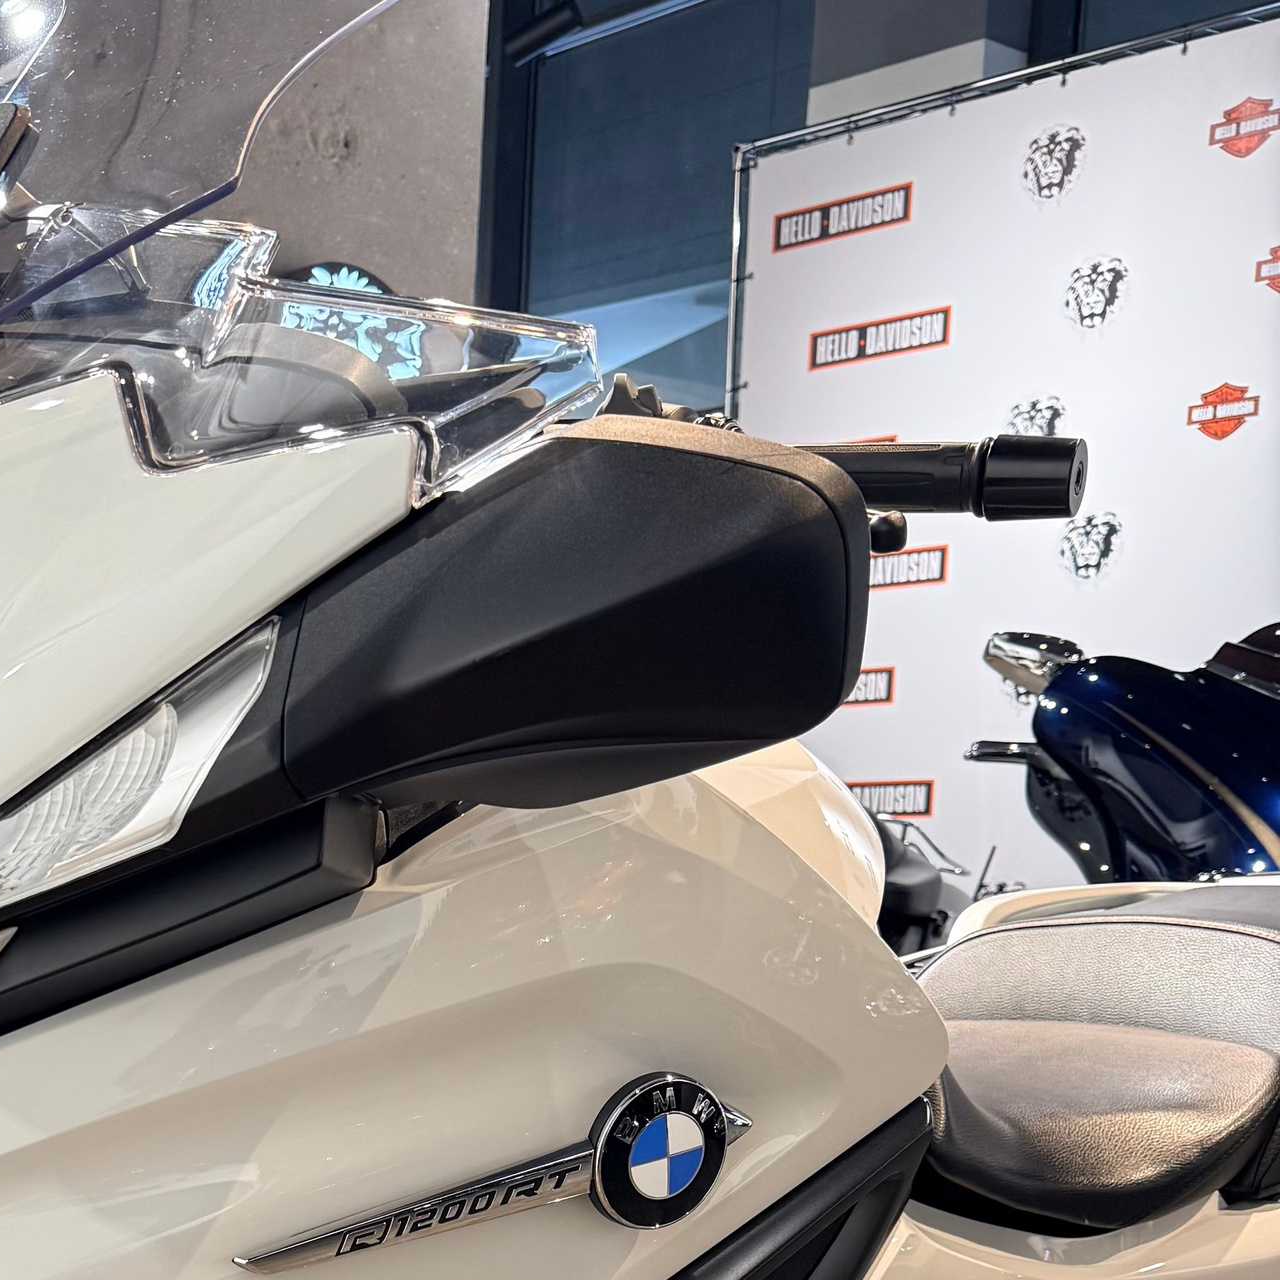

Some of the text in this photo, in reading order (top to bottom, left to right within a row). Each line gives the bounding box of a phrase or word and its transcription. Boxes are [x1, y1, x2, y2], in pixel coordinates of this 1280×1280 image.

[780, 189, 907, 247] HELLO DAVIDSON
[815, 312, 945, 364] HELLO DAVIDSON
[614, 1087, 716, 1145] BMW
